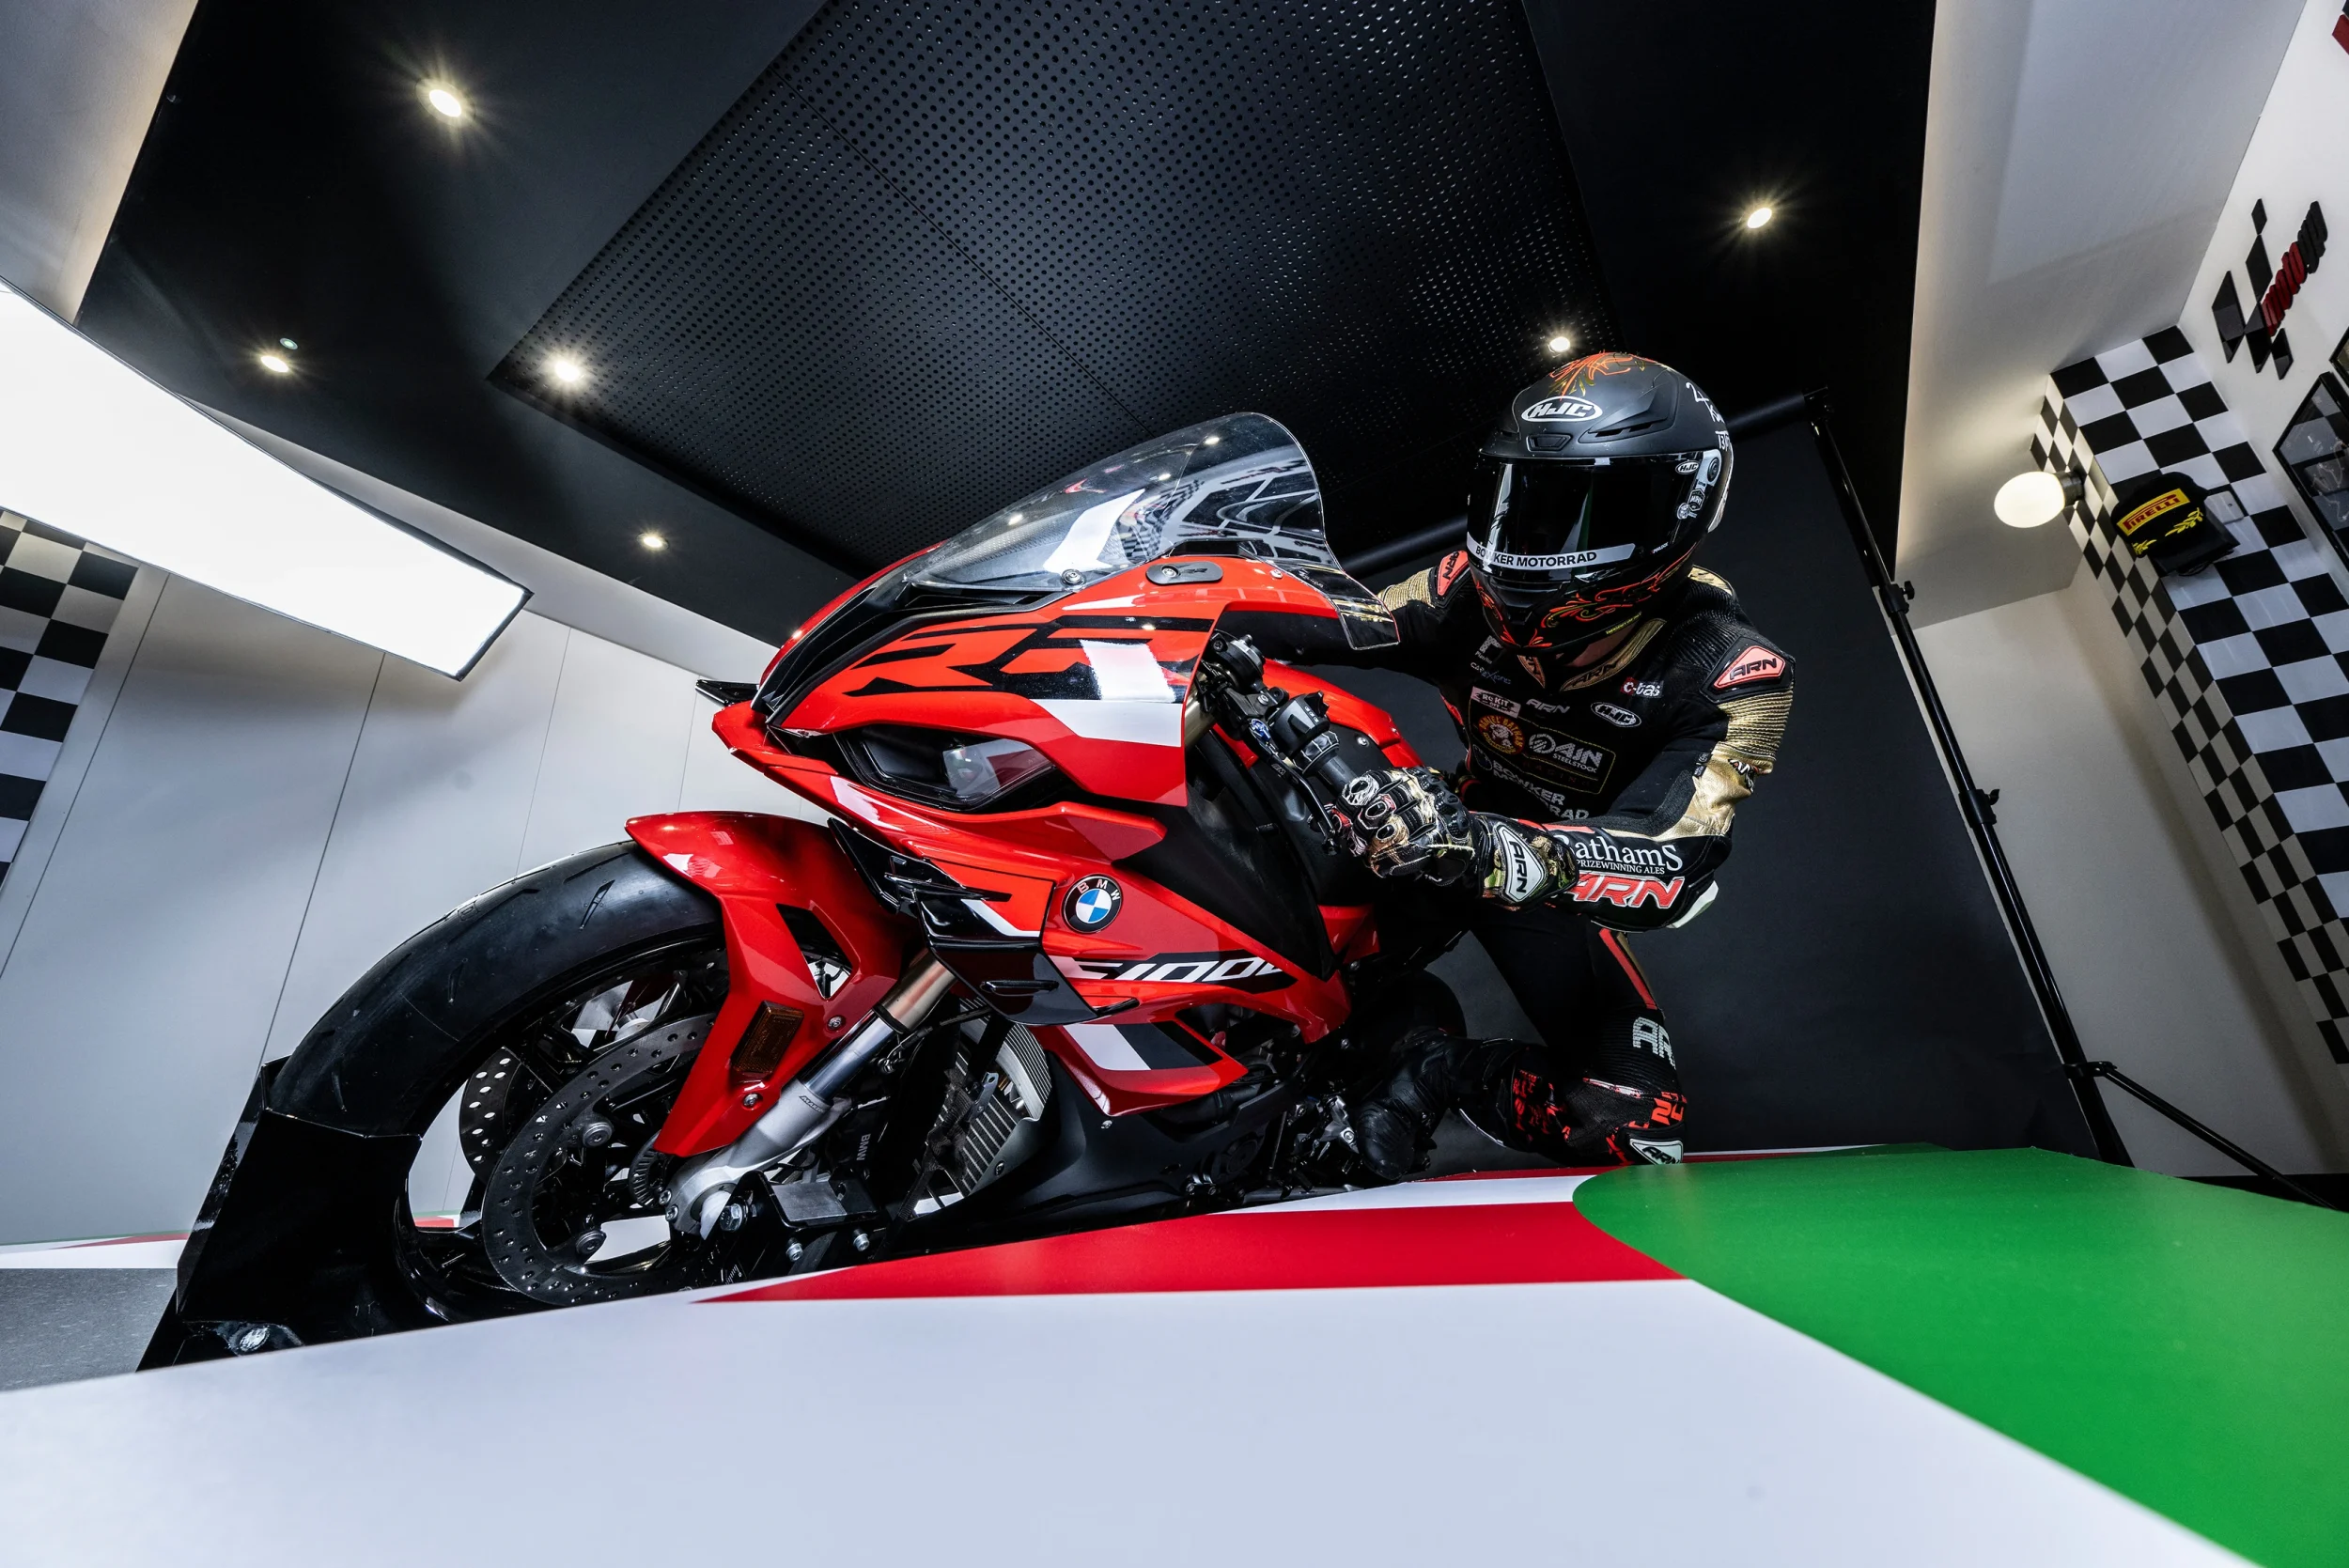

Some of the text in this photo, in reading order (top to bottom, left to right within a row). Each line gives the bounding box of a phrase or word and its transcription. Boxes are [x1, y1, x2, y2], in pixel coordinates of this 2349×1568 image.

[1529, 402, 1593, 418] HJC
[2123, 494, 2181, 531] PIRELLI
[1475, 545, 1597, 567] BOWKER MOTORRAD
[1572, 662, 1617, 687] ARN
[1730, 658, 1778, 680] ARN
[1526, 698, 1570, 714] ARN
[1597, 705, 1634, 722] HJC
[1552, 753, 1597, 773] STEELSTOCK
[1553, 835, 1684, 872] athamS
[1508, 841, 1528, 893] ARN
[1576, 859, 1665, 875] PRIZEWINNING ALES
[1077, 878, 1121, 902] BMW
[1566, 870, 1685, 909] ARN
[856, 1133, 871, 1161] BMW
